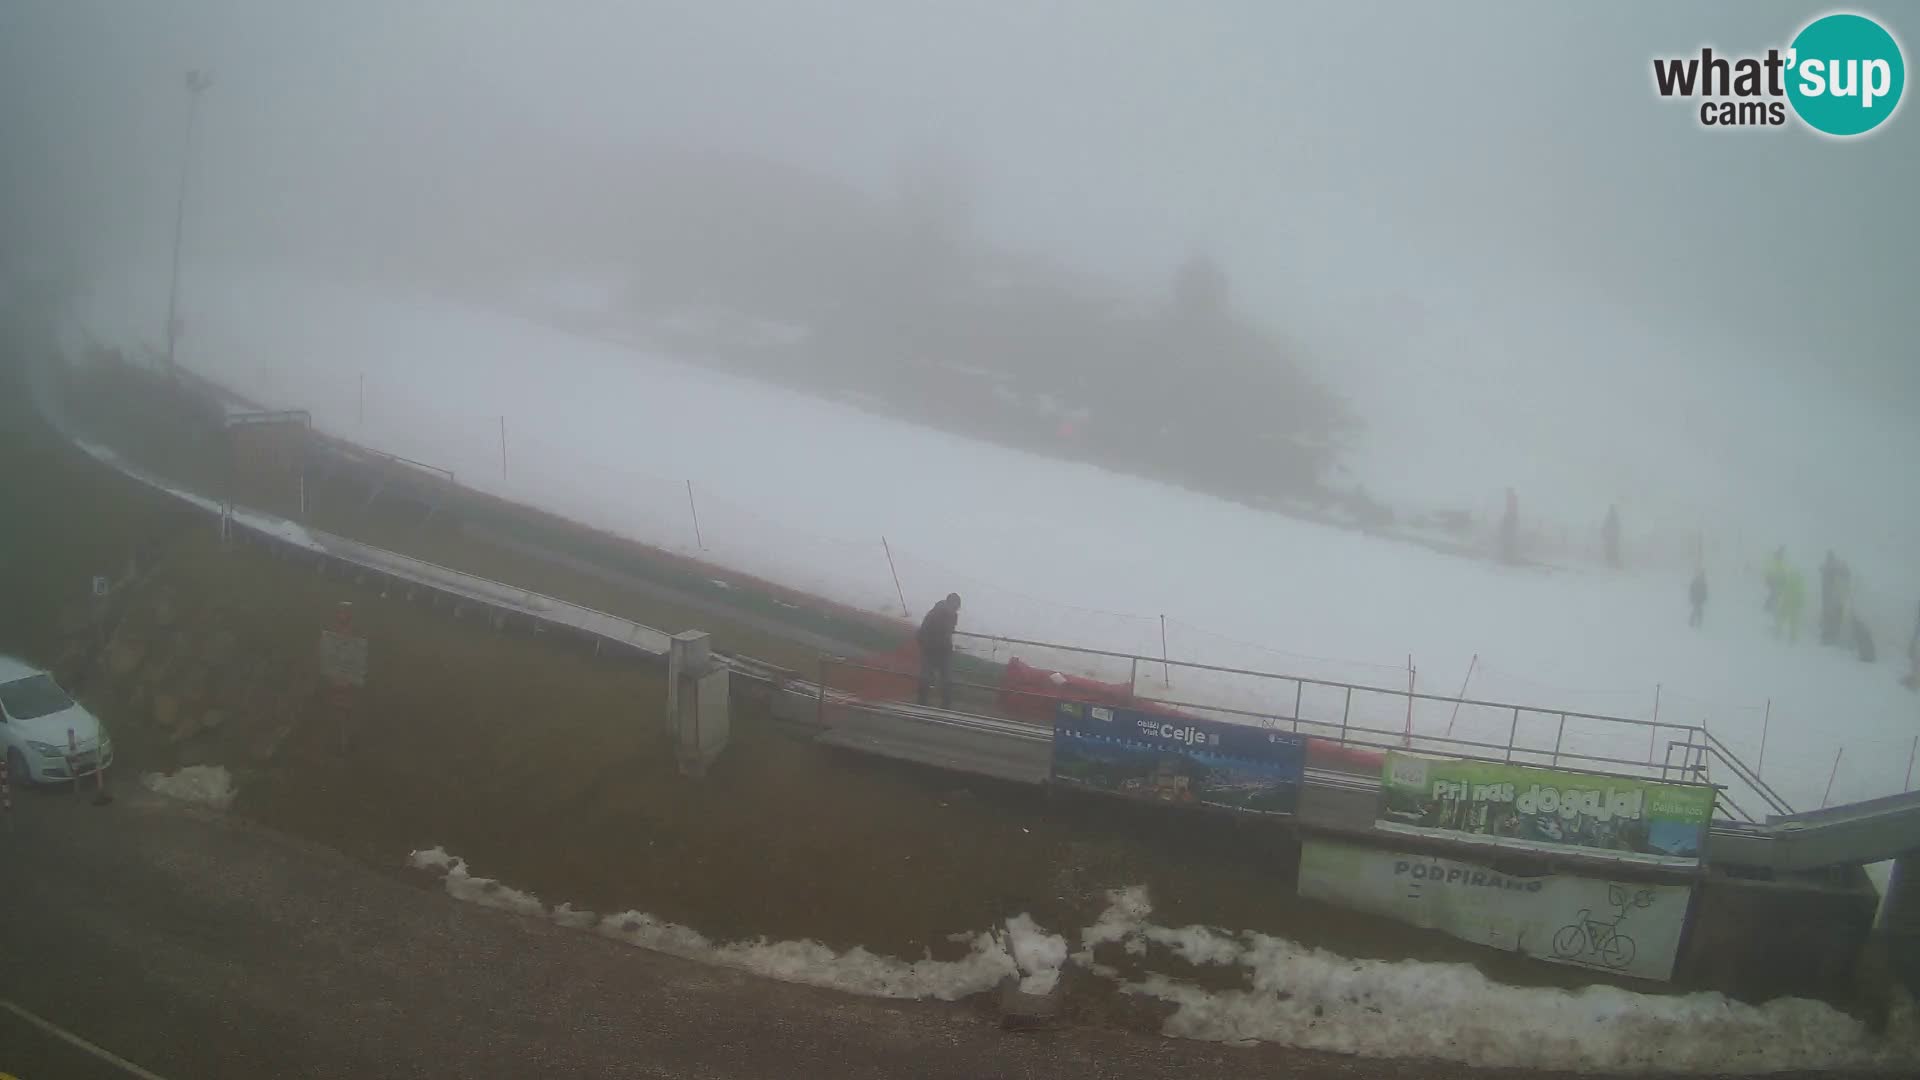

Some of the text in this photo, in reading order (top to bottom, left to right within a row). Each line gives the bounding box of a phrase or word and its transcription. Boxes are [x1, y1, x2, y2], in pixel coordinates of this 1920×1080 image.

[1160, 724, 1206, 745] Celje
[1433, 778, 1468, 800] Pri
[1472, 782, 1514, 802] nas
